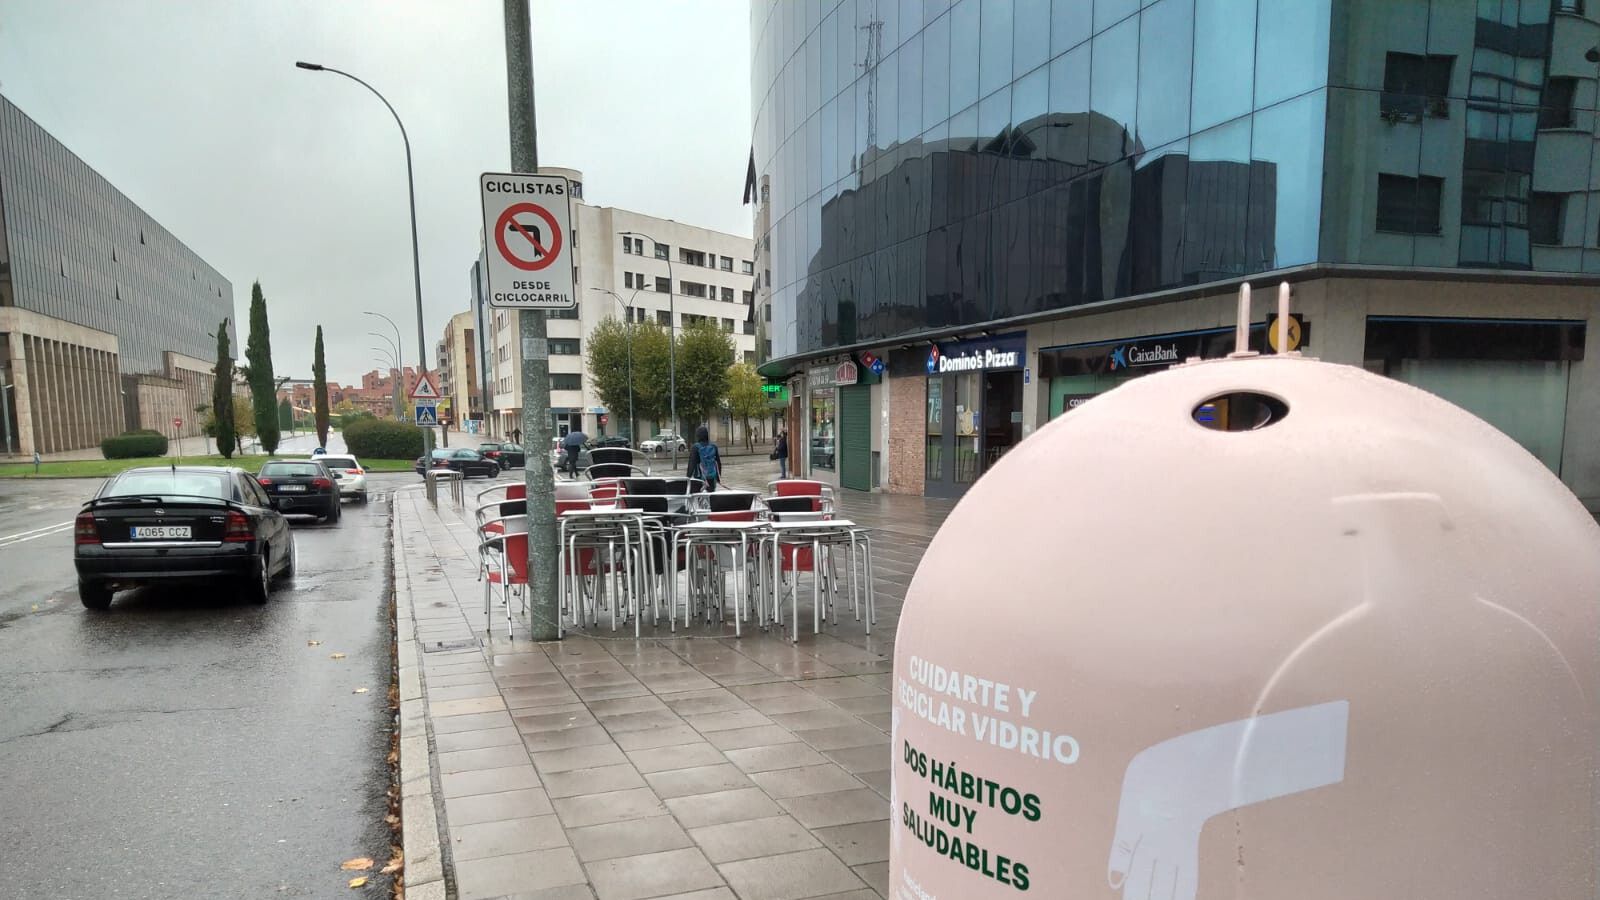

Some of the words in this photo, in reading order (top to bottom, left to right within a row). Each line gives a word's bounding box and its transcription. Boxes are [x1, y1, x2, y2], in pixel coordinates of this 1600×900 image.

[486, 181, 564, 195] CICLISTAS
[513, 281, 551, 290] DESDE
[494, 292, 570, 303] CICLOCARRIL
[939, 350, 983, 372] Domino's
[985, 349, 1017, 368] Pizza
[1128, 343, 1178, 363] CaixaBank
[138, 527, 165, 537] 4065
[168, 527, 191, 537] CCZ
[910, 655, 1010, 713] CUIDARTE
[1017, 687, 1037, 718] Y
[971, 712, 1080, 765] VIDRIO
[904, 738, 928, 778] DOS
[931, 758, 1042, 822] HÁBITOS
[929, 791, 977, 834] MUY
[903, 801, 1031, 892] SALUDABLES
